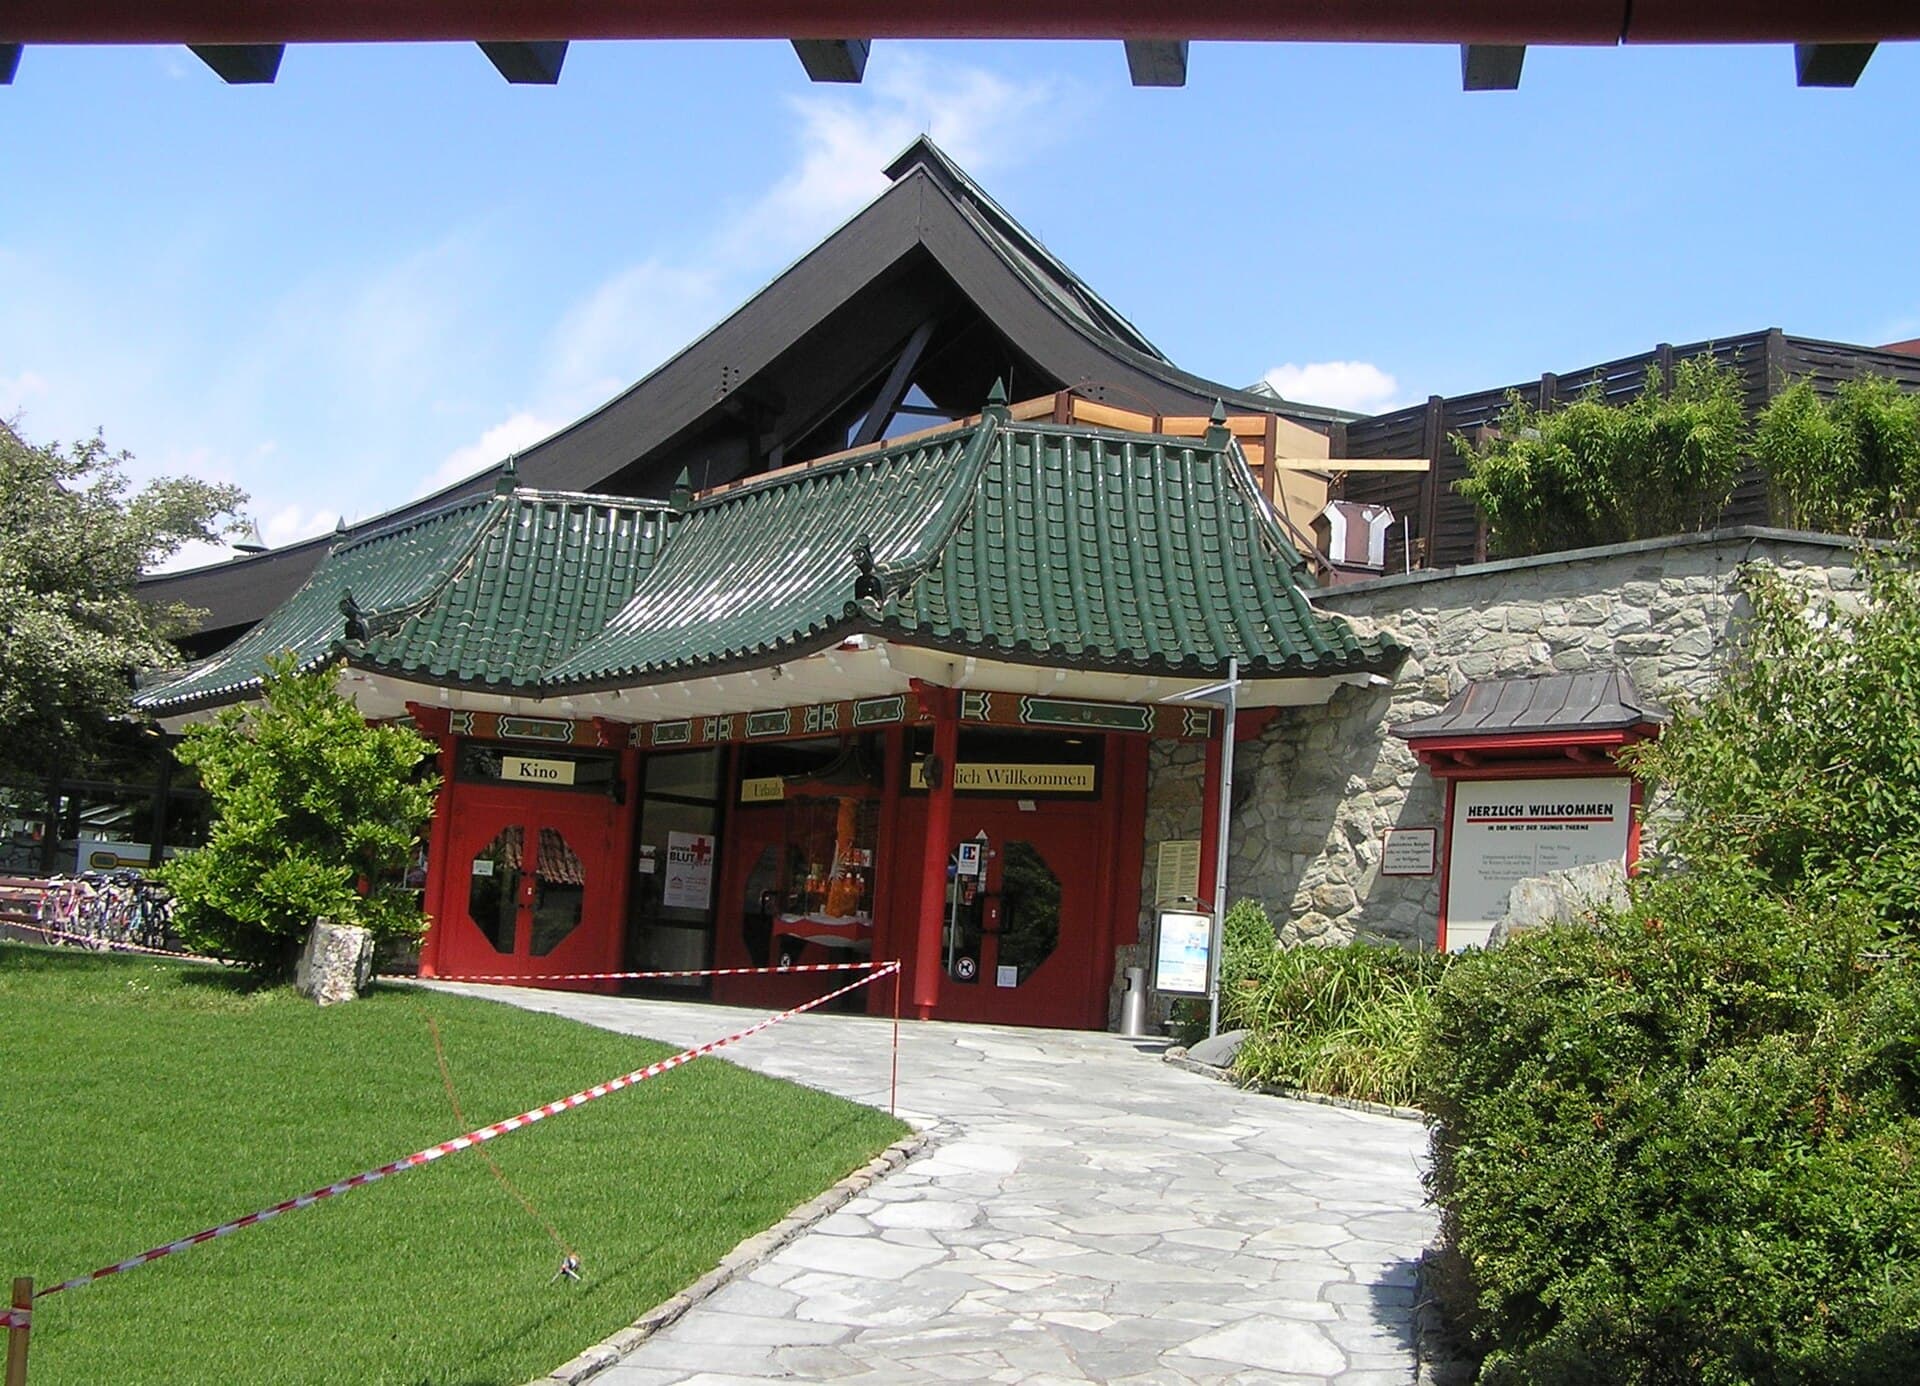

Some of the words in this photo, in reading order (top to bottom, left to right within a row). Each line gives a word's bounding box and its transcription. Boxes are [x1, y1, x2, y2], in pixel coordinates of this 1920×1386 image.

[520, 762, 558, 779] Kino
[986, 769, 1087, 786] Willkommen
[1468, 805, 1524, 817] HERZLICH
[1529, 803, 1614, 816] WILLKOMMEN
[670, 852, 695, 862] BLUT
